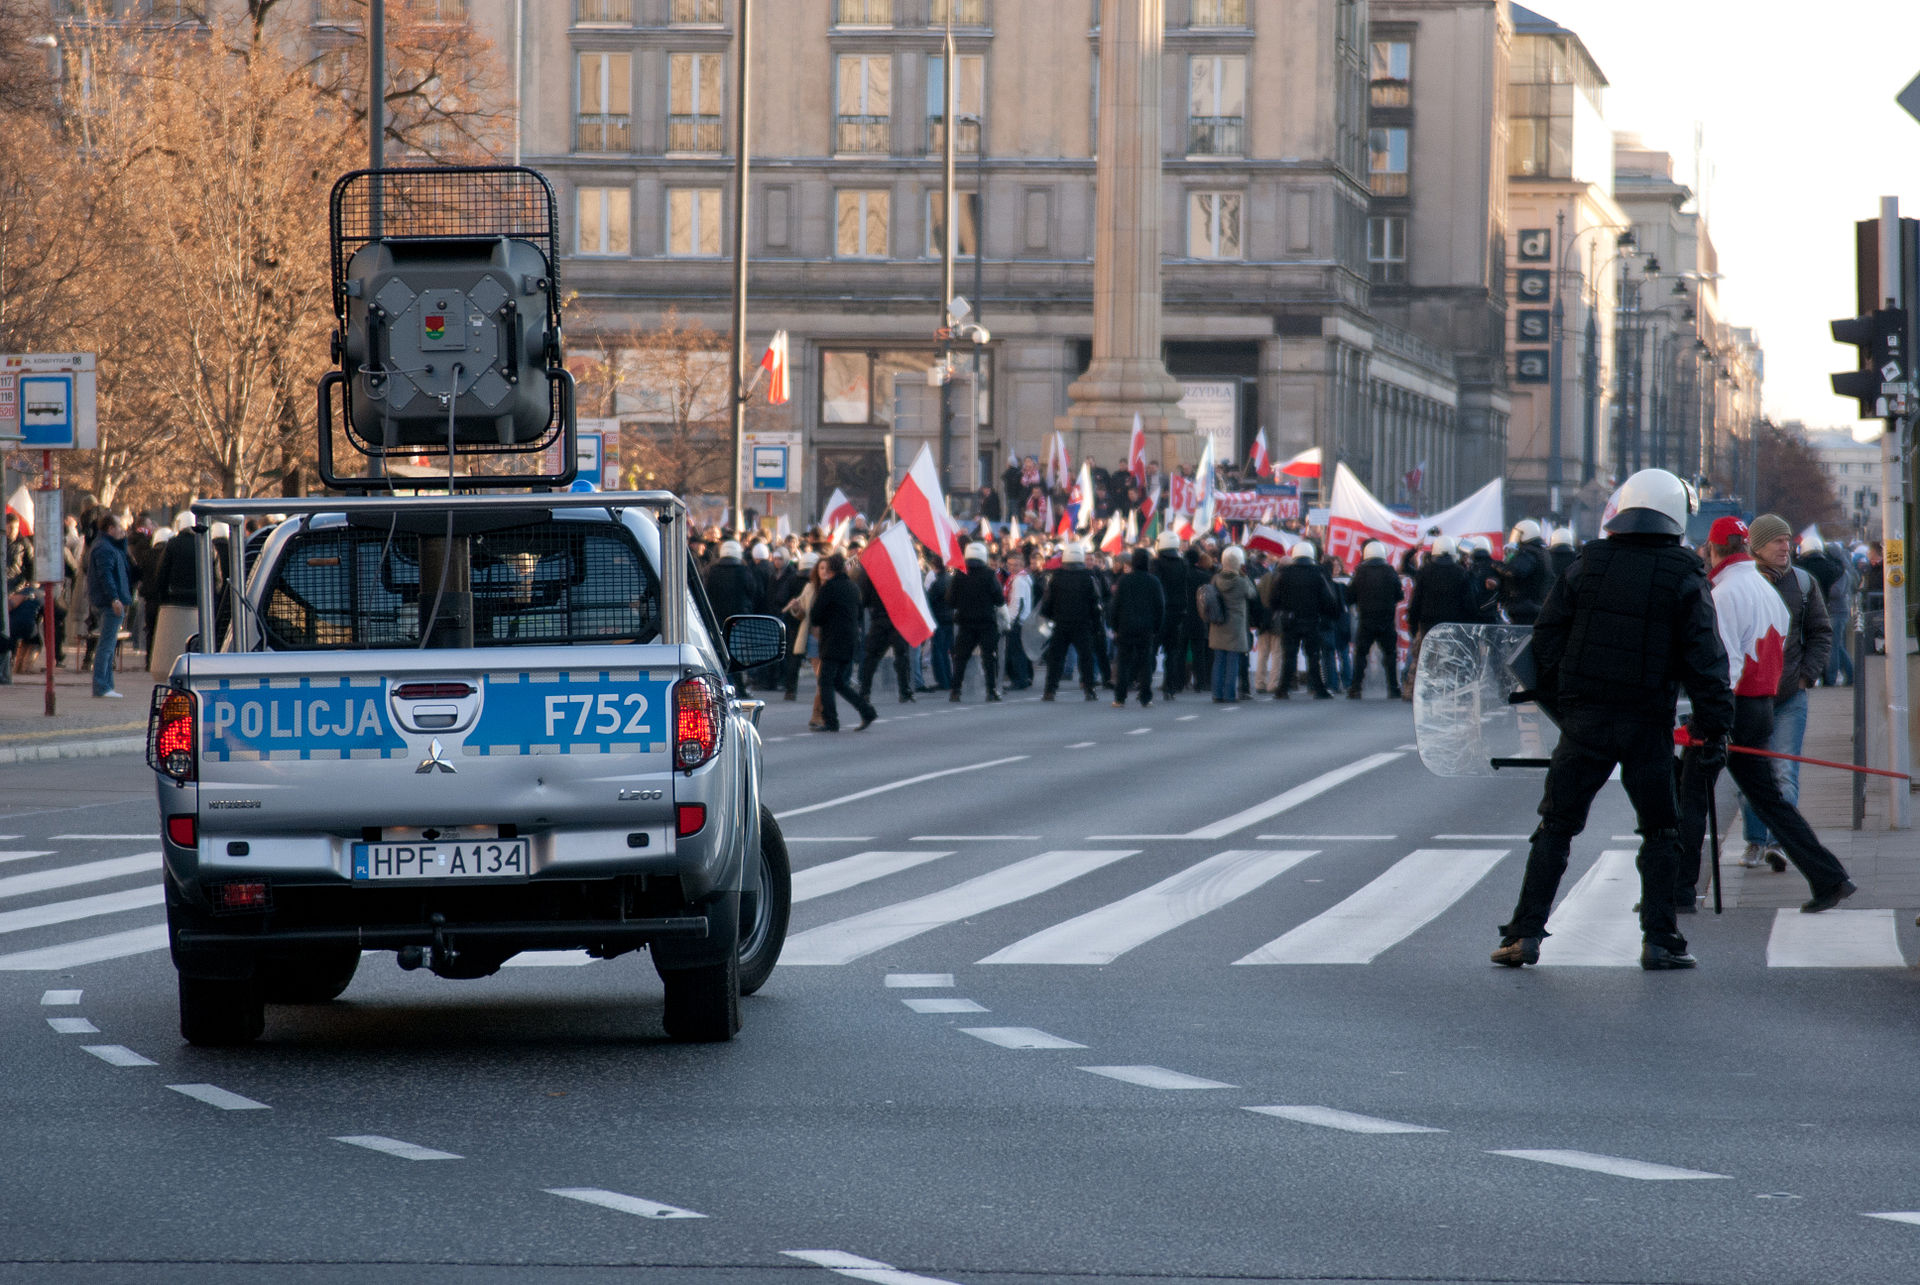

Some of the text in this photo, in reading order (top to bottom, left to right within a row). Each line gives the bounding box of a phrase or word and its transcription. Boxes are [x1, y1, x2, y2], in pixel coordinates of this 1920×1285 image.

[1520, 232, 1545, 376] desa
[214, 698, 383, 739] POLICJA
[544, 693, 651, 737] F752
[208, 799, 262, 810] MITSUBISHI
[617, 788, 663, 801] L200
[356, 866, 368, 875] PL
[374, 844, 521, 876] HPF A134
